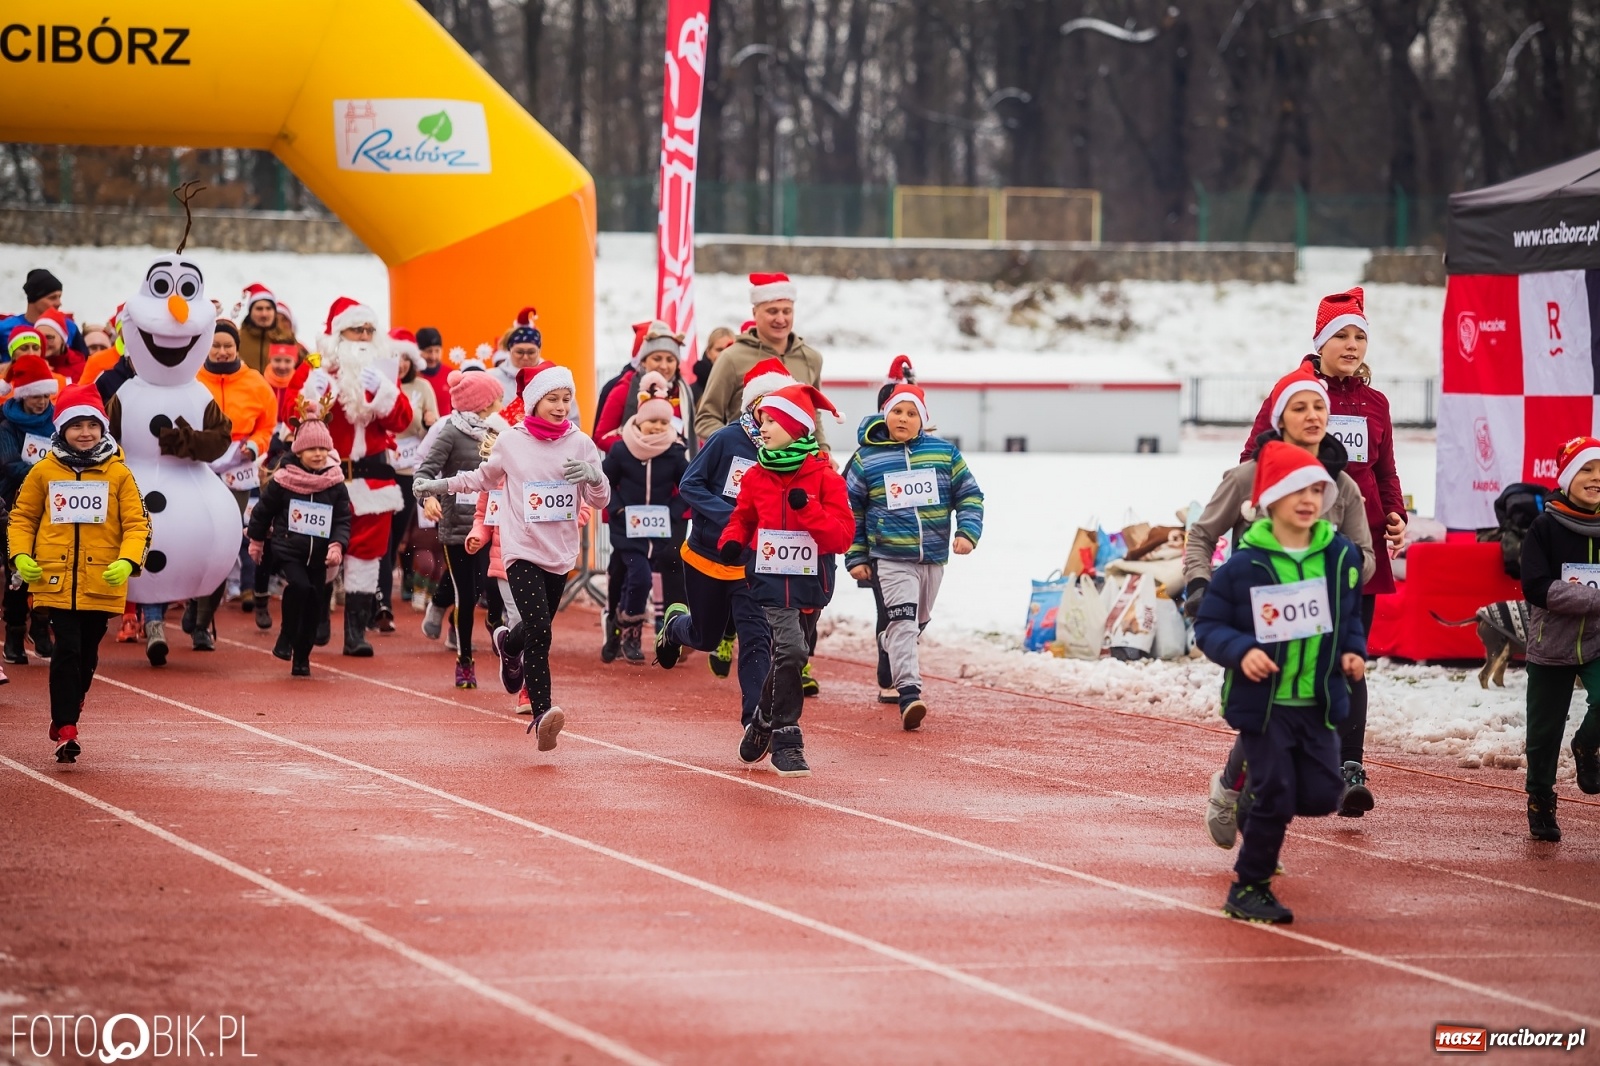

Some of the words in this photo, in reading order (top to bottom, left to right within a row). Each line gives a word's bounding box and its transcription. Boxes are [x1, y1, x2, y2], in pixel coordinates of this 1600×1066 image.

[0, 17, 191, 65] CIBÓRZ
[352, 128, 480, 172] Racibórz
[1512, 220, 1600, 247] www.raciborz.pl
[1546, 301, 1562, 340] R
[236, 467, 254, 481] 037
[904, 481, 933, 496] 003
[68, 495, 102, 510] 008
[544, 493, 574, 509] 082
[303, 512, 326, 527] 185
[642, 516, 666, 528] 032
[777, 545, 812, 561] 070
[1283, 599, 1319, 622] 016
